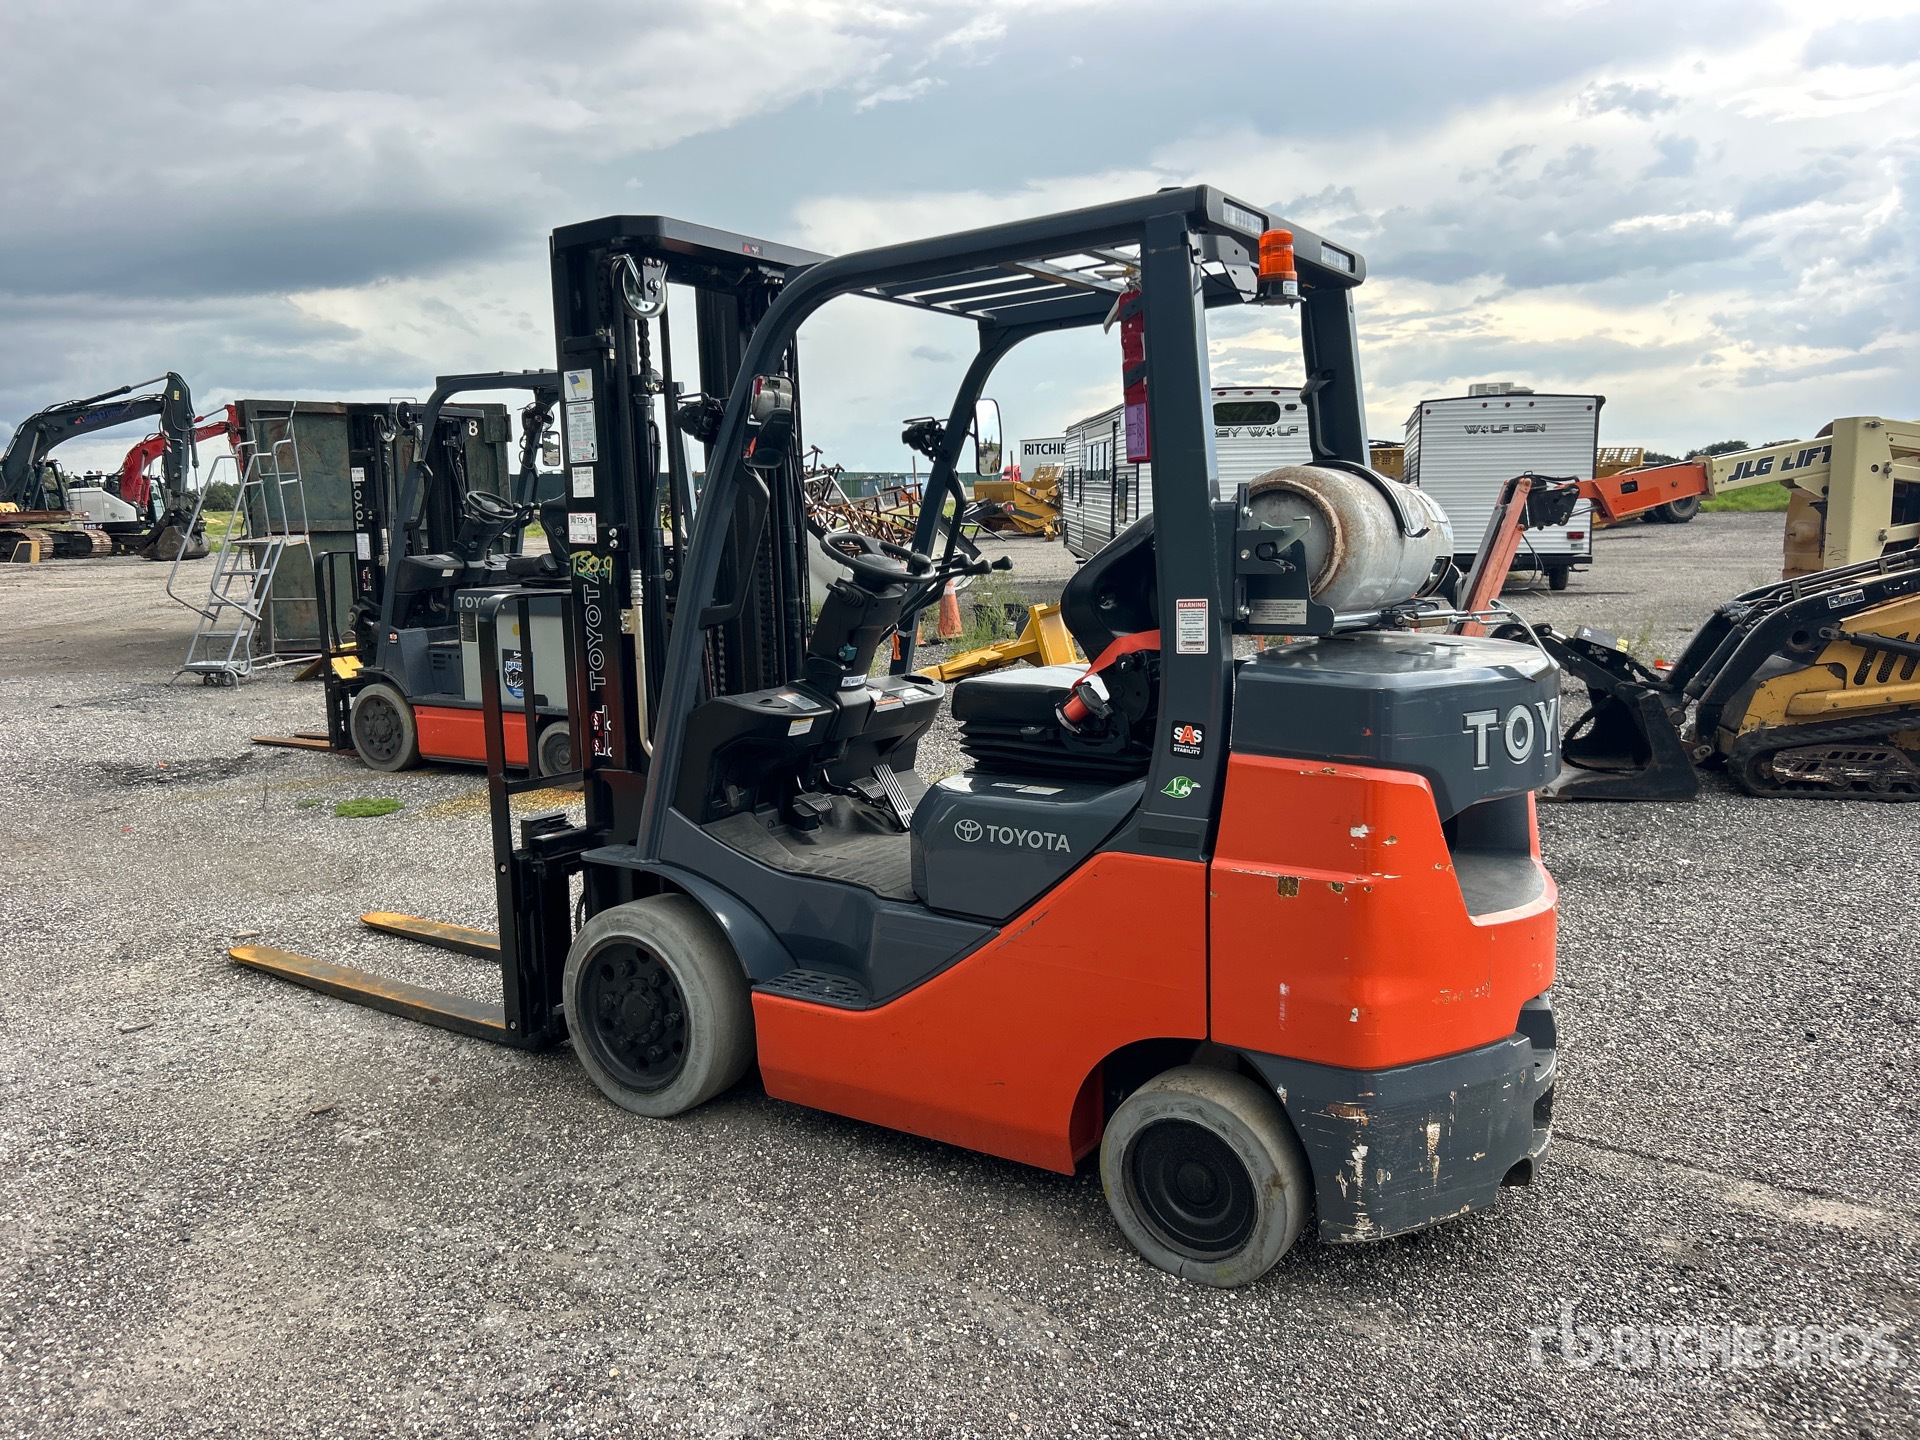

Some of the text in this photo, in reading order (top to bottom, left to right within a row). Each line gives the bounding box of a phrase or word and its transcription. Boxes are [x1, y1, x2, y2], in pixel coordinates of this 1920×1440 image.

[467, 420, 479, 437] 8
[1513, 424, 1546, 433] DEN
[1024, 442, 1066, 455] RITCHIE
[1727, 445, 1832, 482] JLG LIFT
[353, 481, 365, 530] TOYOT
[1173, 725, 1203, 745] SAS
[1462, 694, 1561, 771] TOY
[1173, 747, 1201, 755] STABILITY
[986, 824, 1071, 853] TOYOTA
